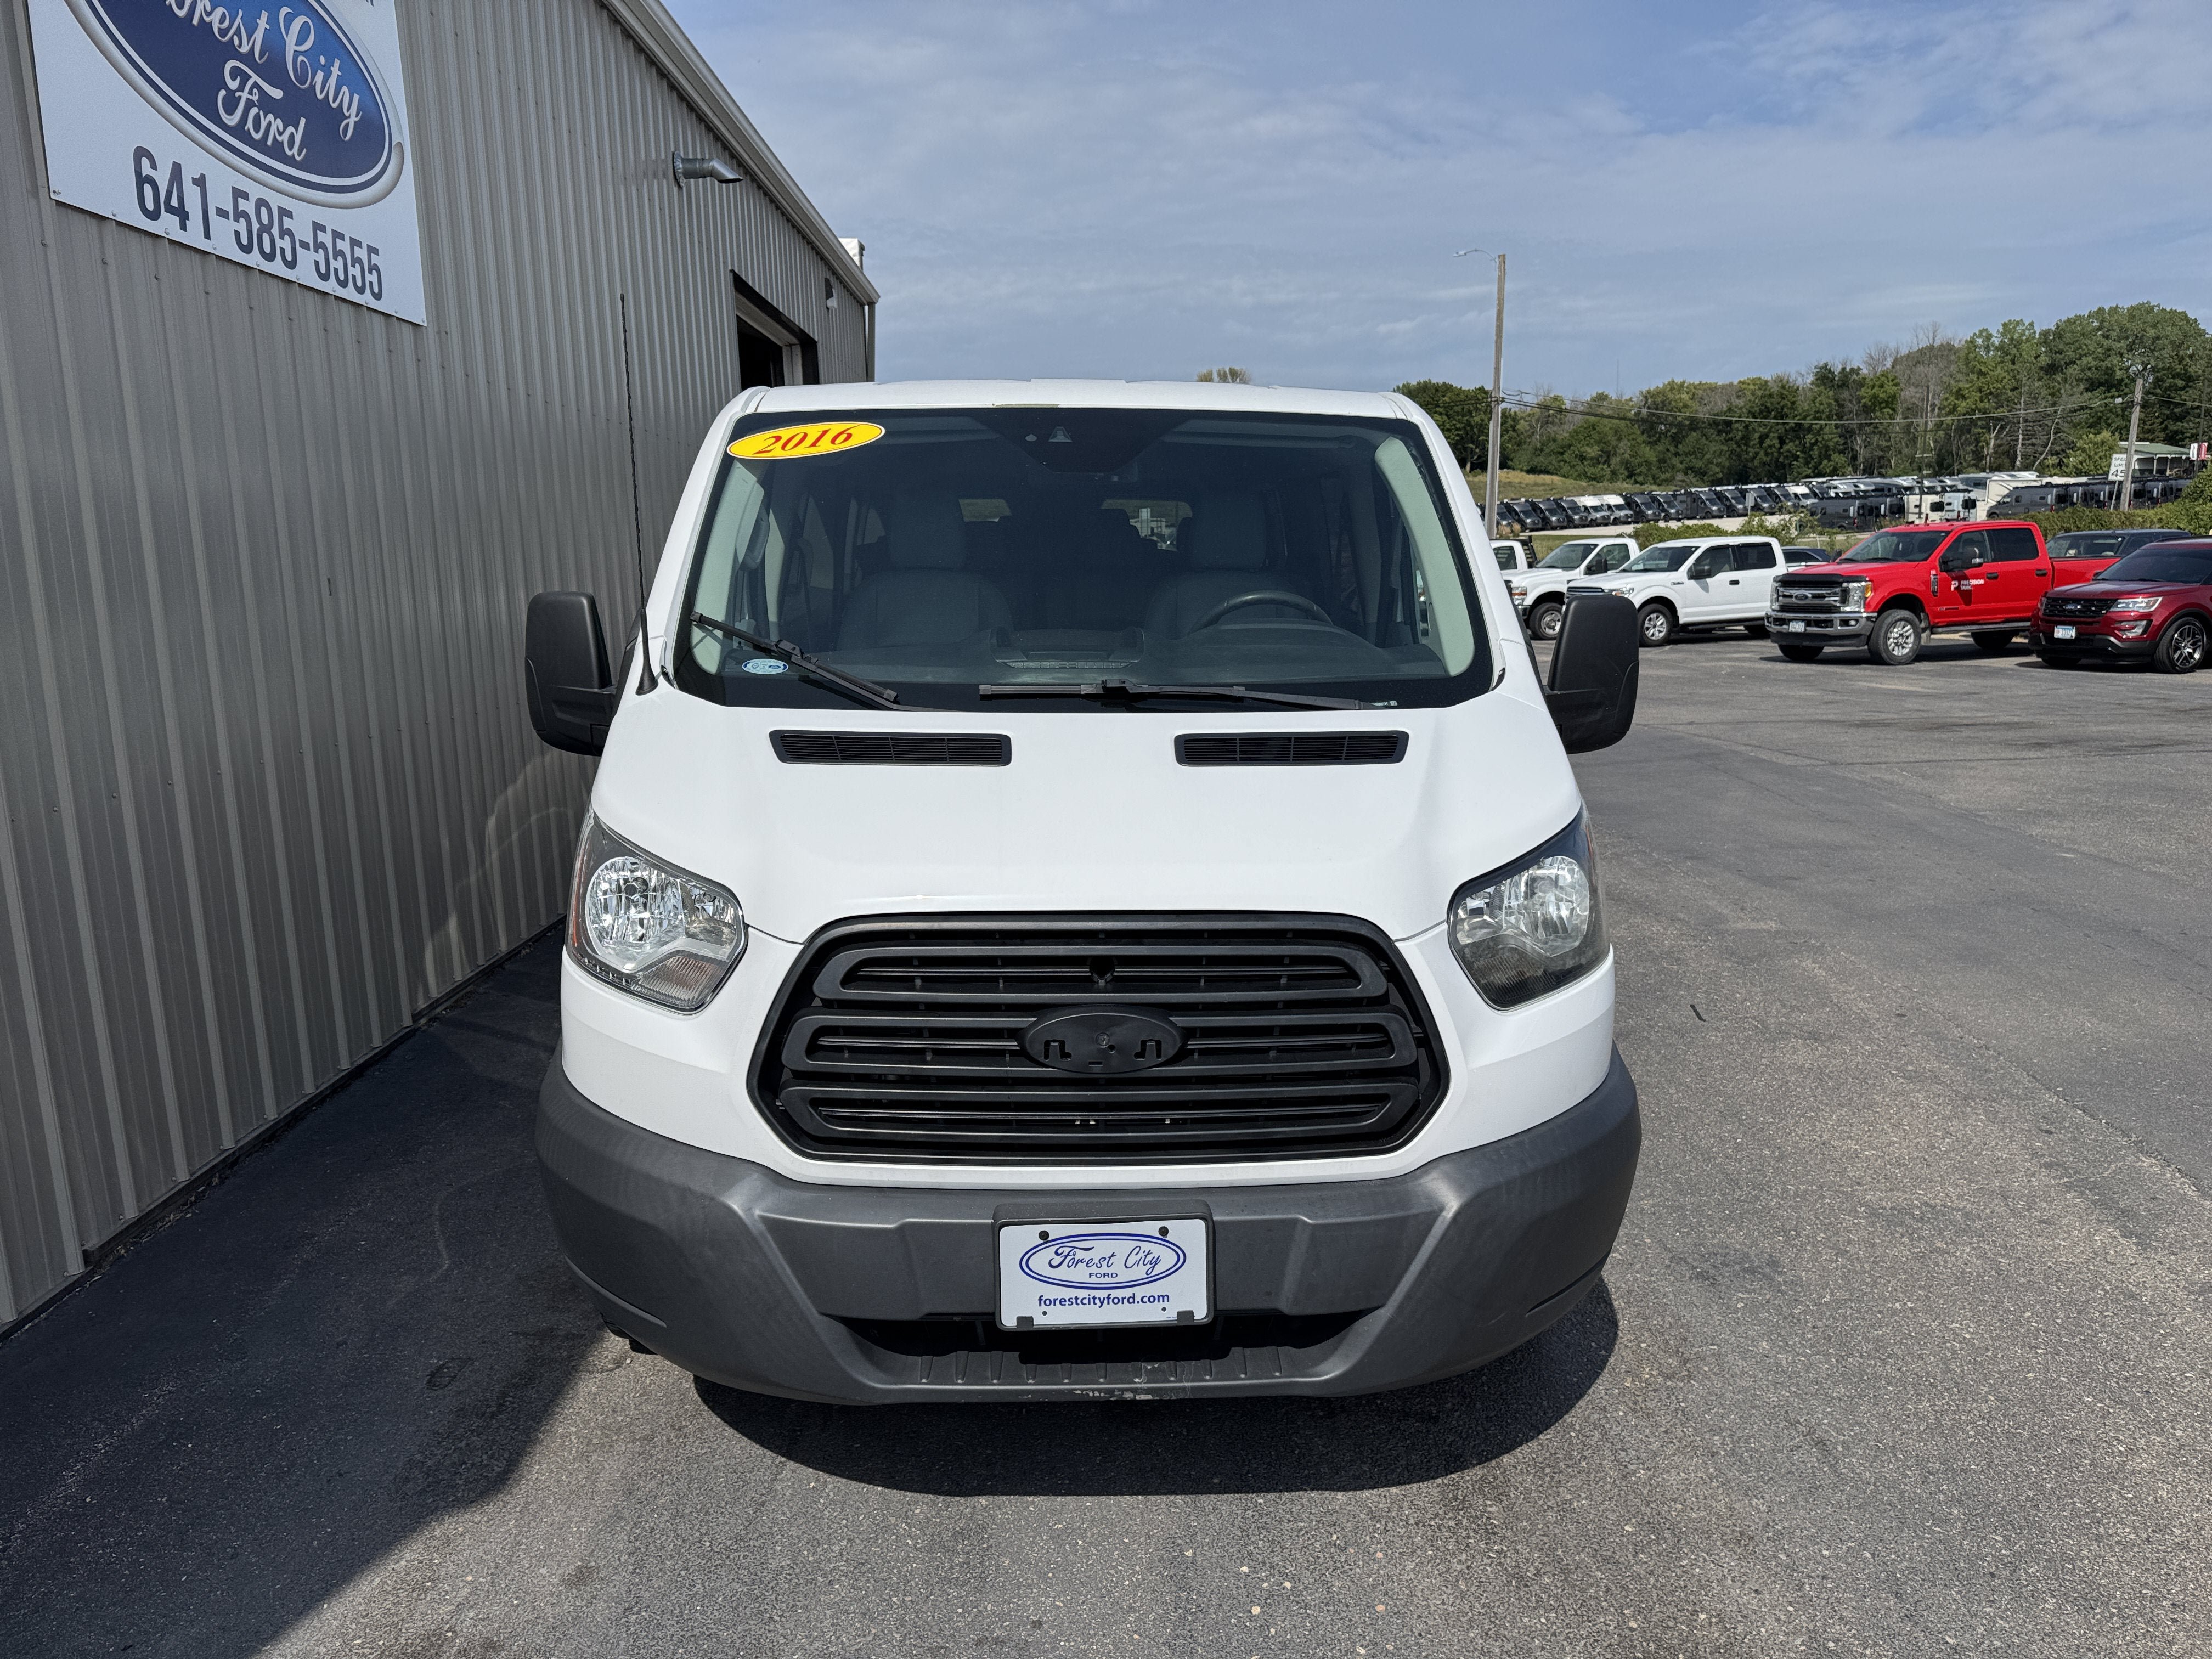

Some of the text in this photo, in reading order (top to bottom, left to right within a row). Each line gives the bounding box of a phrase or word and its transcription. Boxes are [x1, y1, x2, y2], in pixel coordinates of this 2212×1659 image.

[165, 0, 363, 142] orest City
[217, 59, 307, 161] Ford
[133, 145, 383, 301] 641-585-5555
[752, 425, 860, 455] 2016
[2111, 469, 2125, 477] 45
[1048, 1245, 1162, 1276] Forest City
[1037, 1293, 1170, 1308] forestcityford.com
